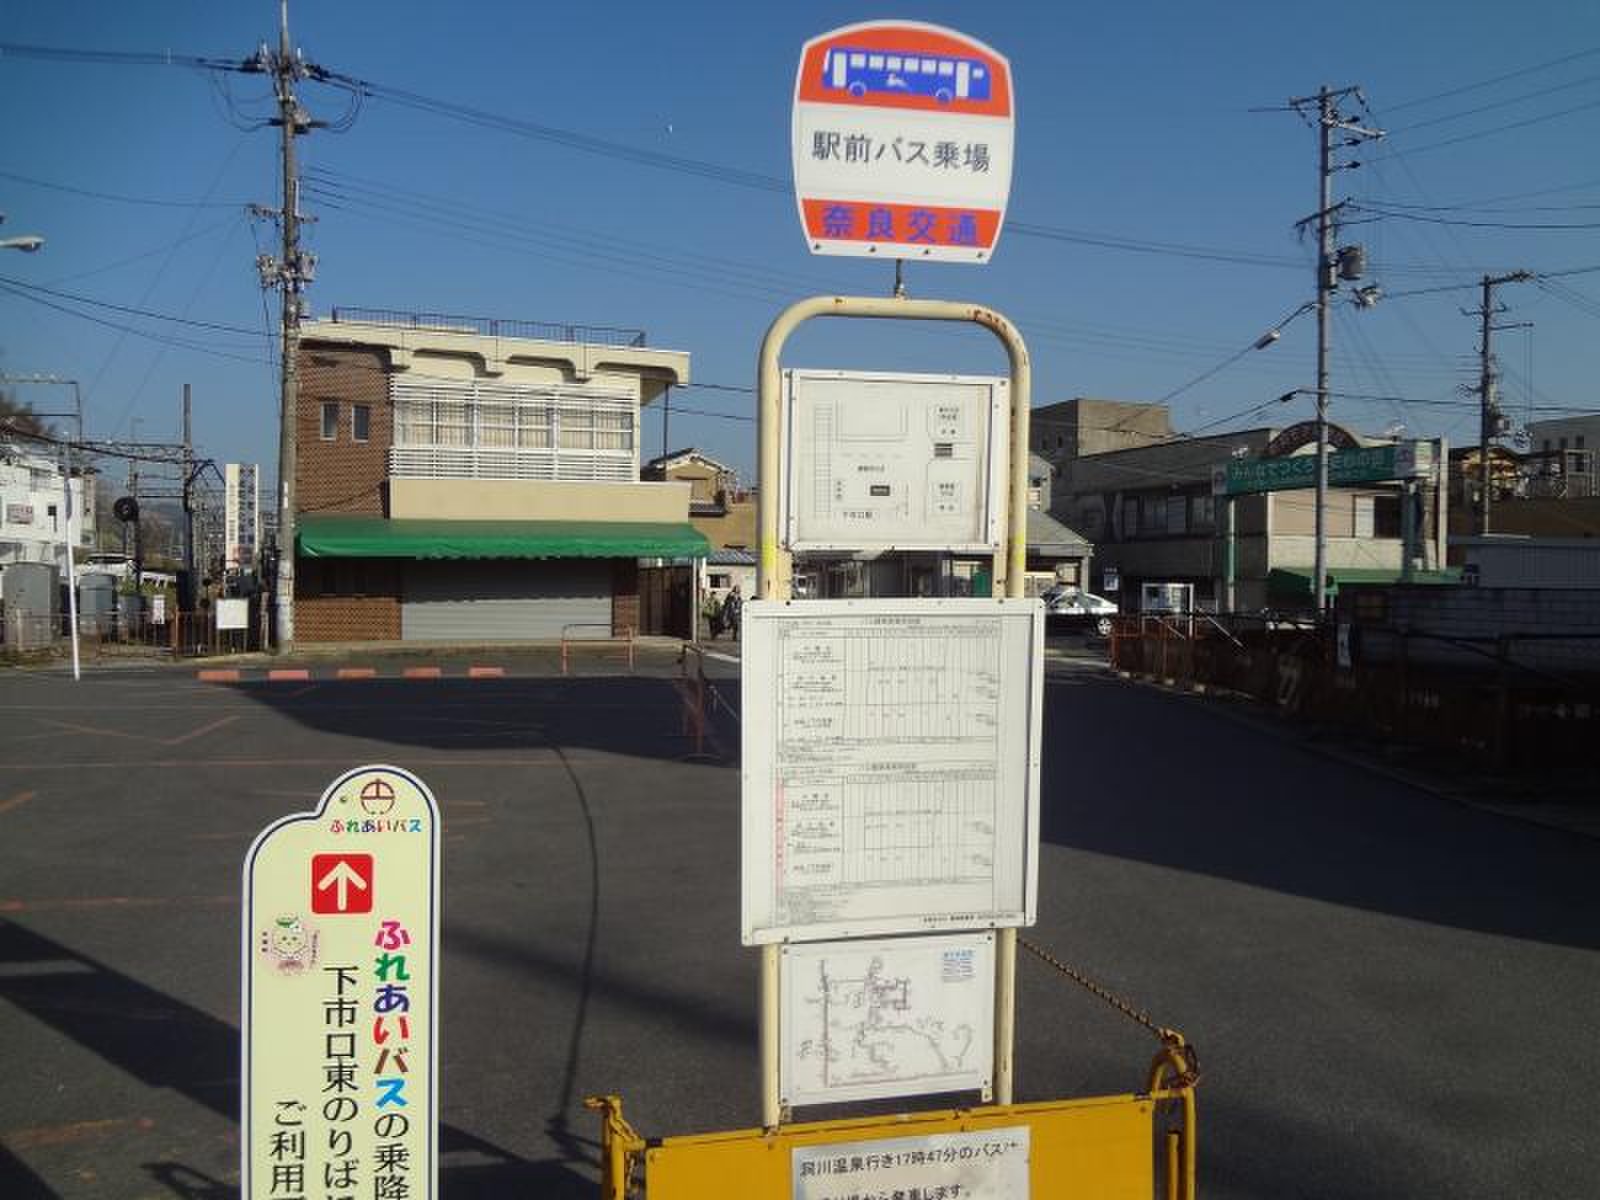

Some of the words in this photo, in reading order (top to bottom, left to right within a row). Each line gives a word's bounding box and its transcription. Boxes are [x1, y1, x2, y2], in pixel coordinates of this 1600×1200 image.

[812, 131, 992, 173] 駅前バス乗場
[823, 204, 979, 247] 奈良交通
[330, 819, 422, 833] ふれあいバス
[322, 966, 359, 1200] 下市口東のりば
[374, 920, 411, 1200] ふれあいバスの乗降
[270, 1100, 307, 1200] ご利用
